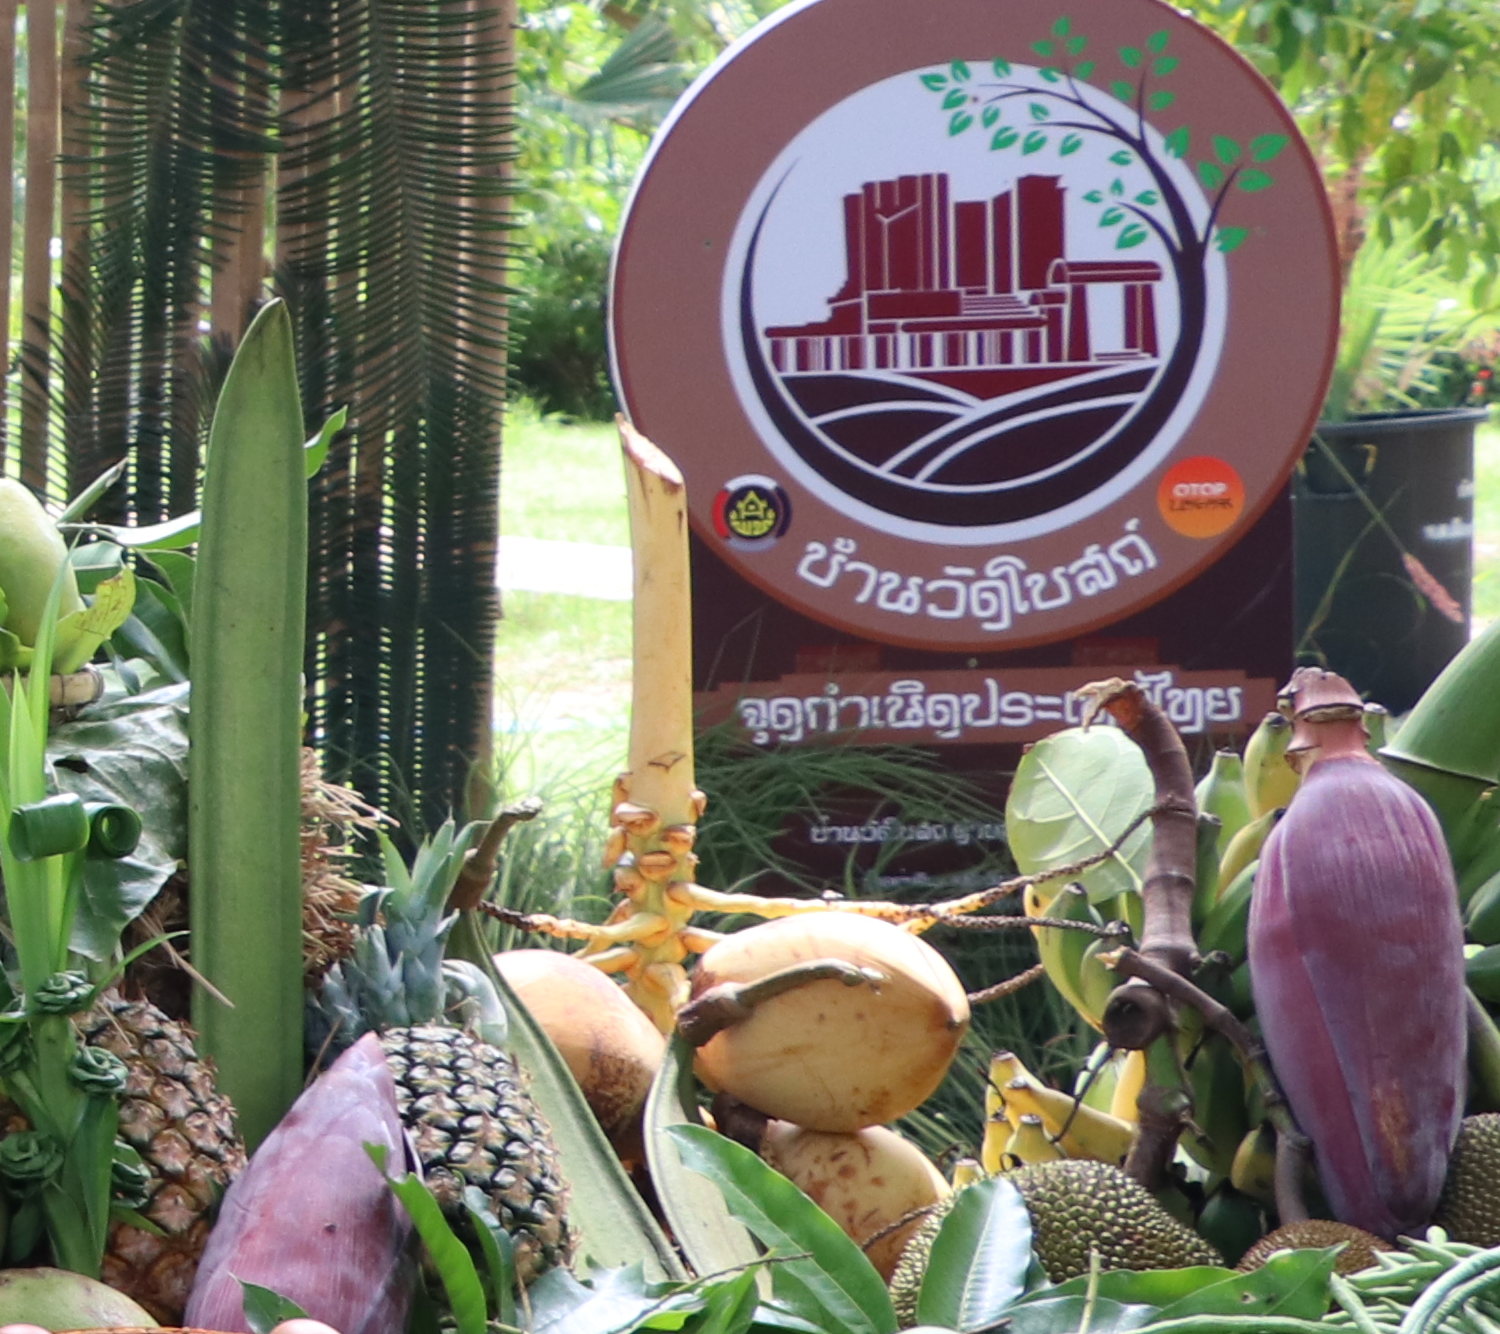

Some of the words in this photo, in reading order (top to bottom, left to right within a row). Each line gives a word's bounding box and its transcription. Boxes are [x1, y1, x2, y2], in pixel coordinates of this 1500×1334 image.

[796, 519, 1158, 632] บ้านวัดโบสถ์
